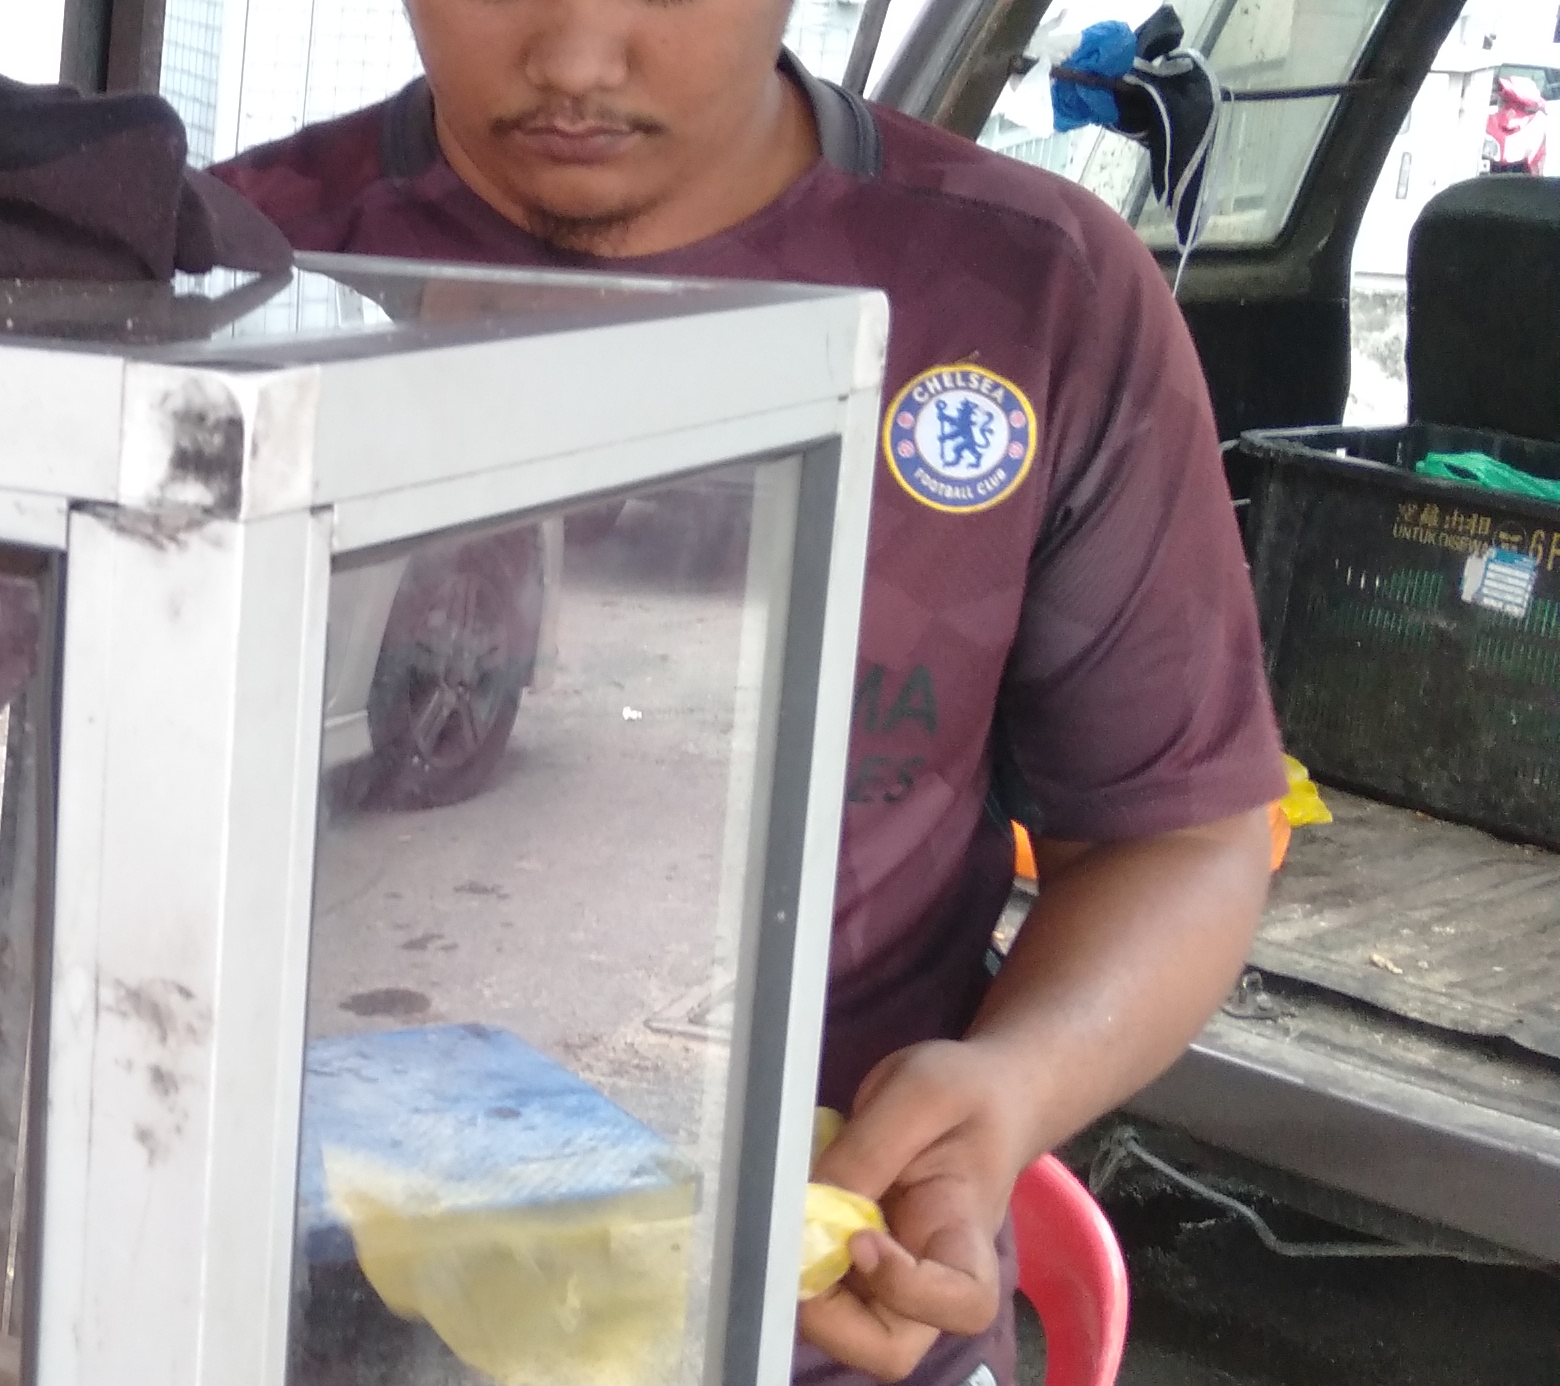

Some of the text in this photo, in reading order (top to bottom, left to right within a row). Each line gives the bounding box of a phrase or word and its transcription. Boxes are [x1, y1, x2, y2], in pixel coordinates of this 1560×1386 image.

[912, 371, 1006, 404] CHELSEA
[914, 467, 1007, 500] FOOTBALL CLUB
